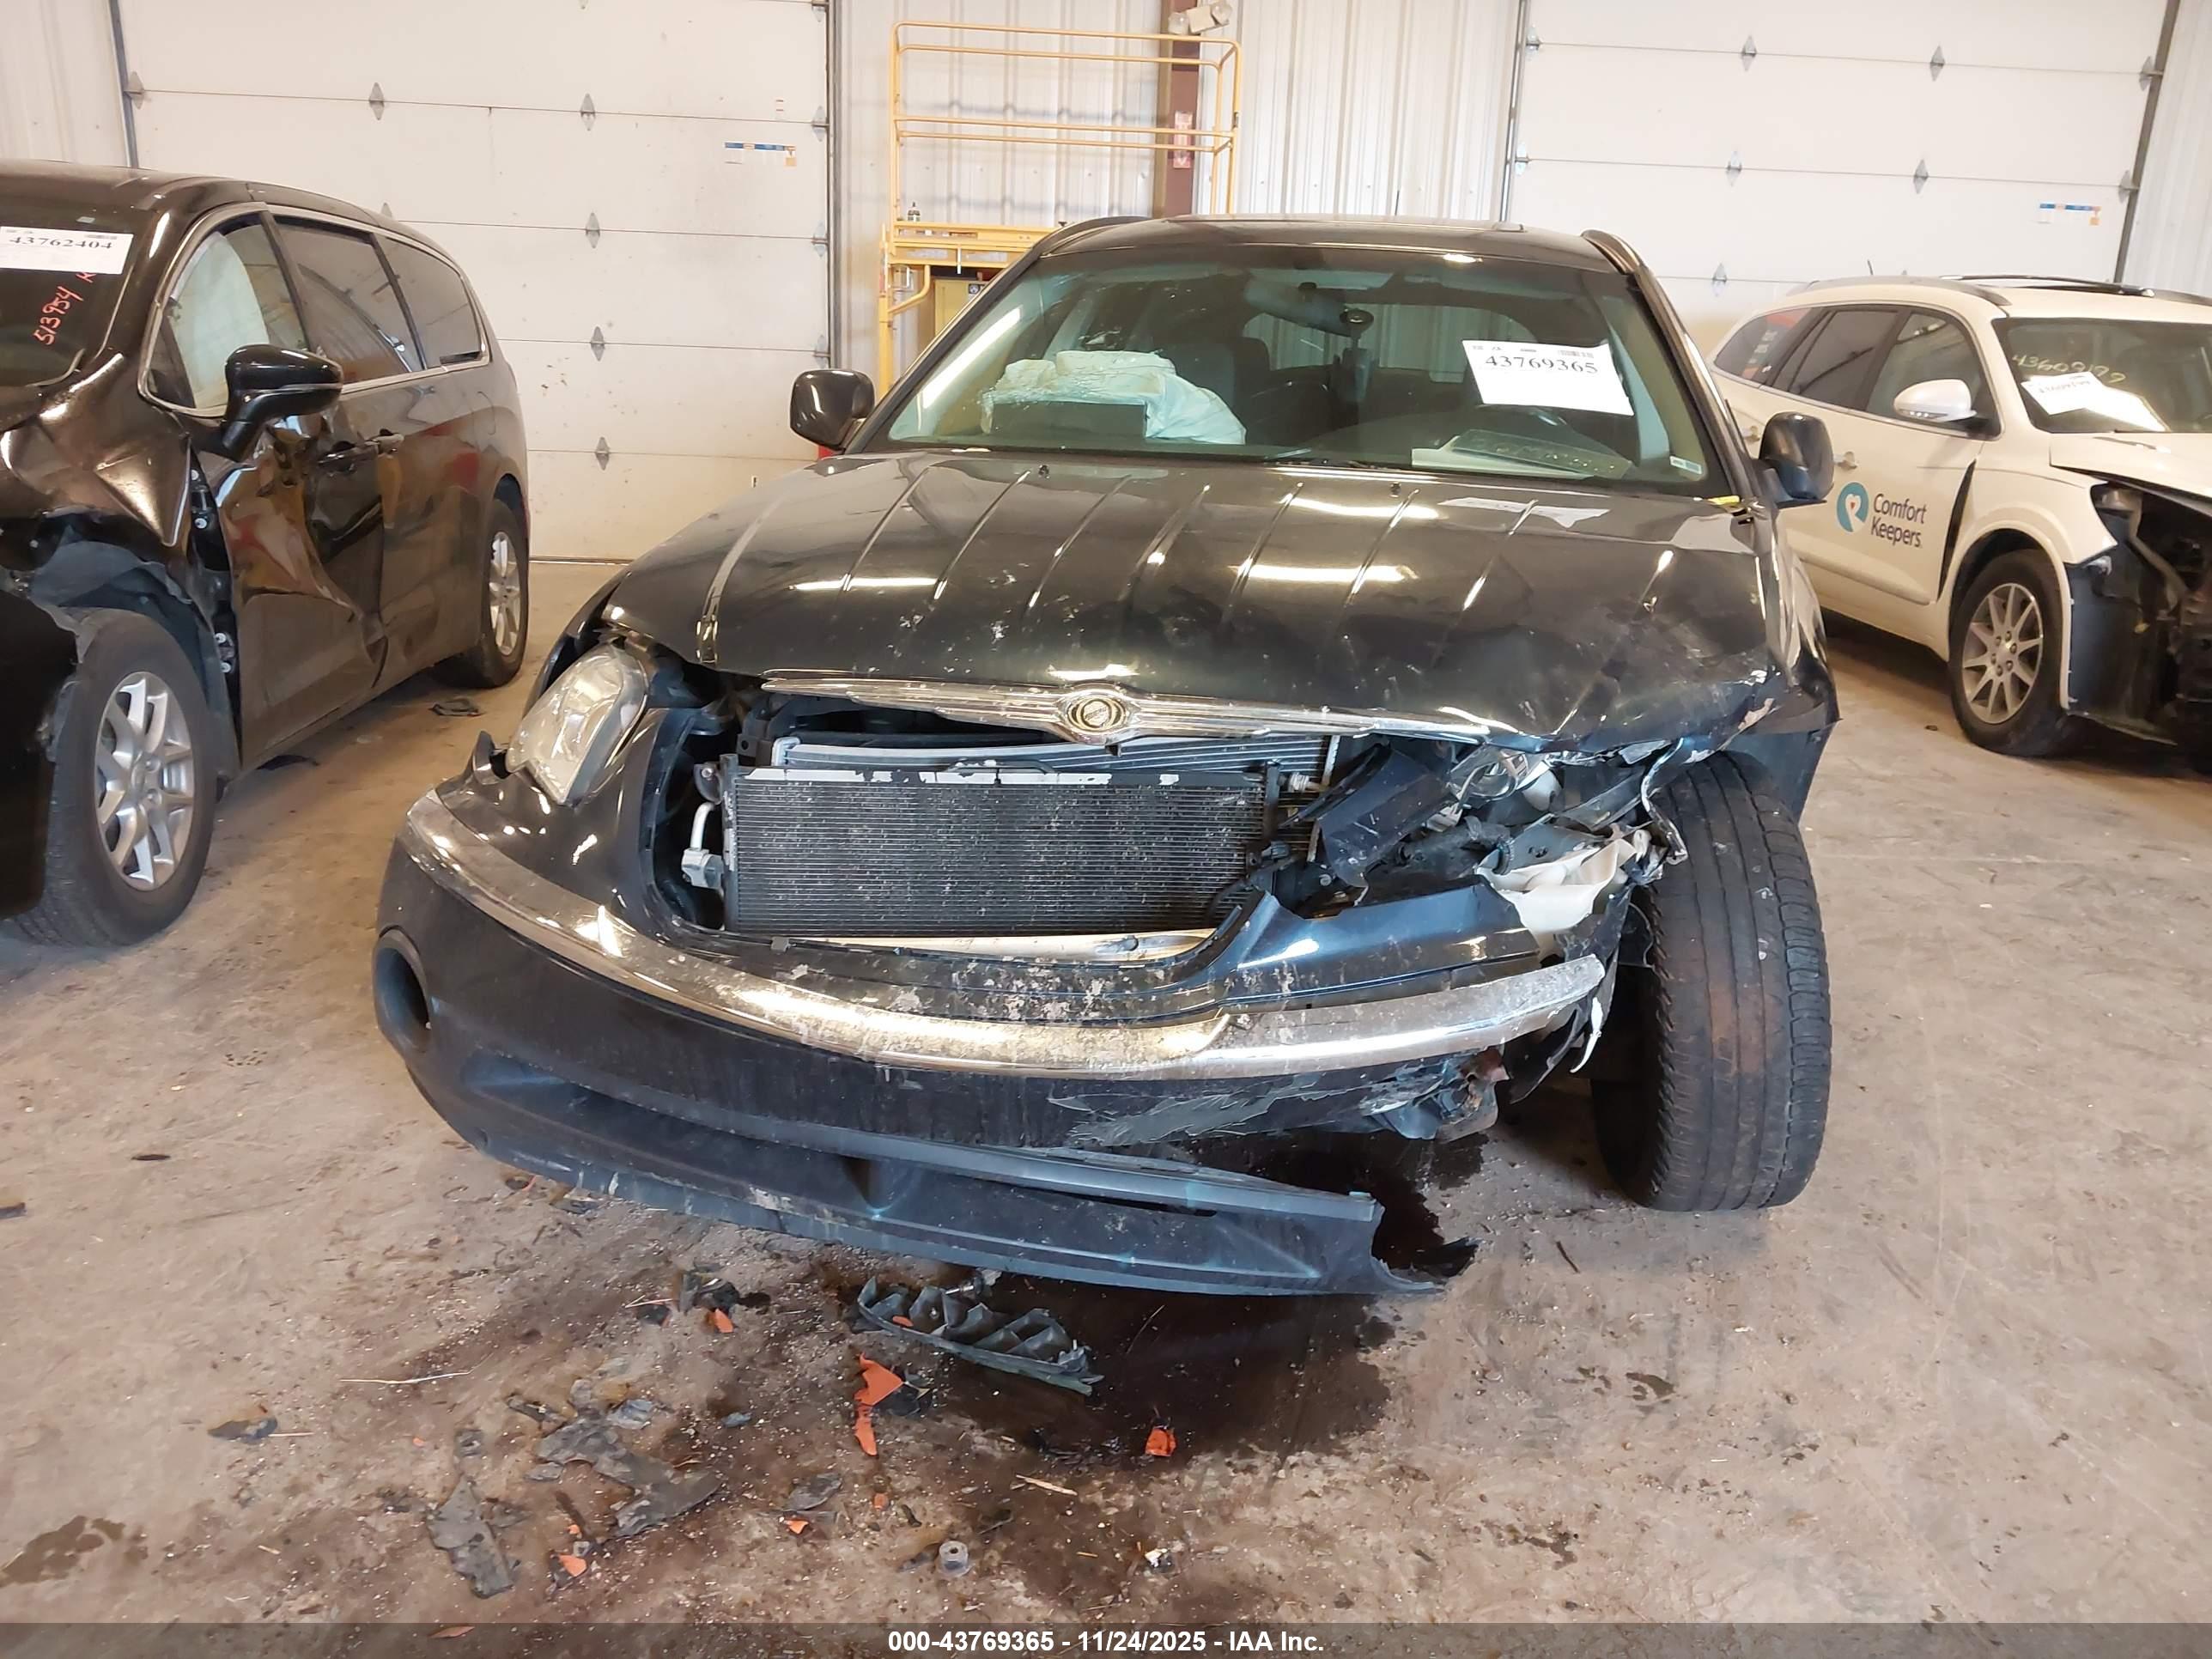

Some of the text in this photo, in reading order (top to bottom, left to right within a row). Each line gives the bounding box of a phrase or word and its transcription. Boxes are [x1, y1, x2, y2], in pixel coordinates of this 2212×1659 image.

[9, 235, 113, 249] 43762404
[1485, 356, 1599, 374] 43769365
[1873, 492, 1928, 525] Comfort
[1870, 516, 1923, 549] Keepers
